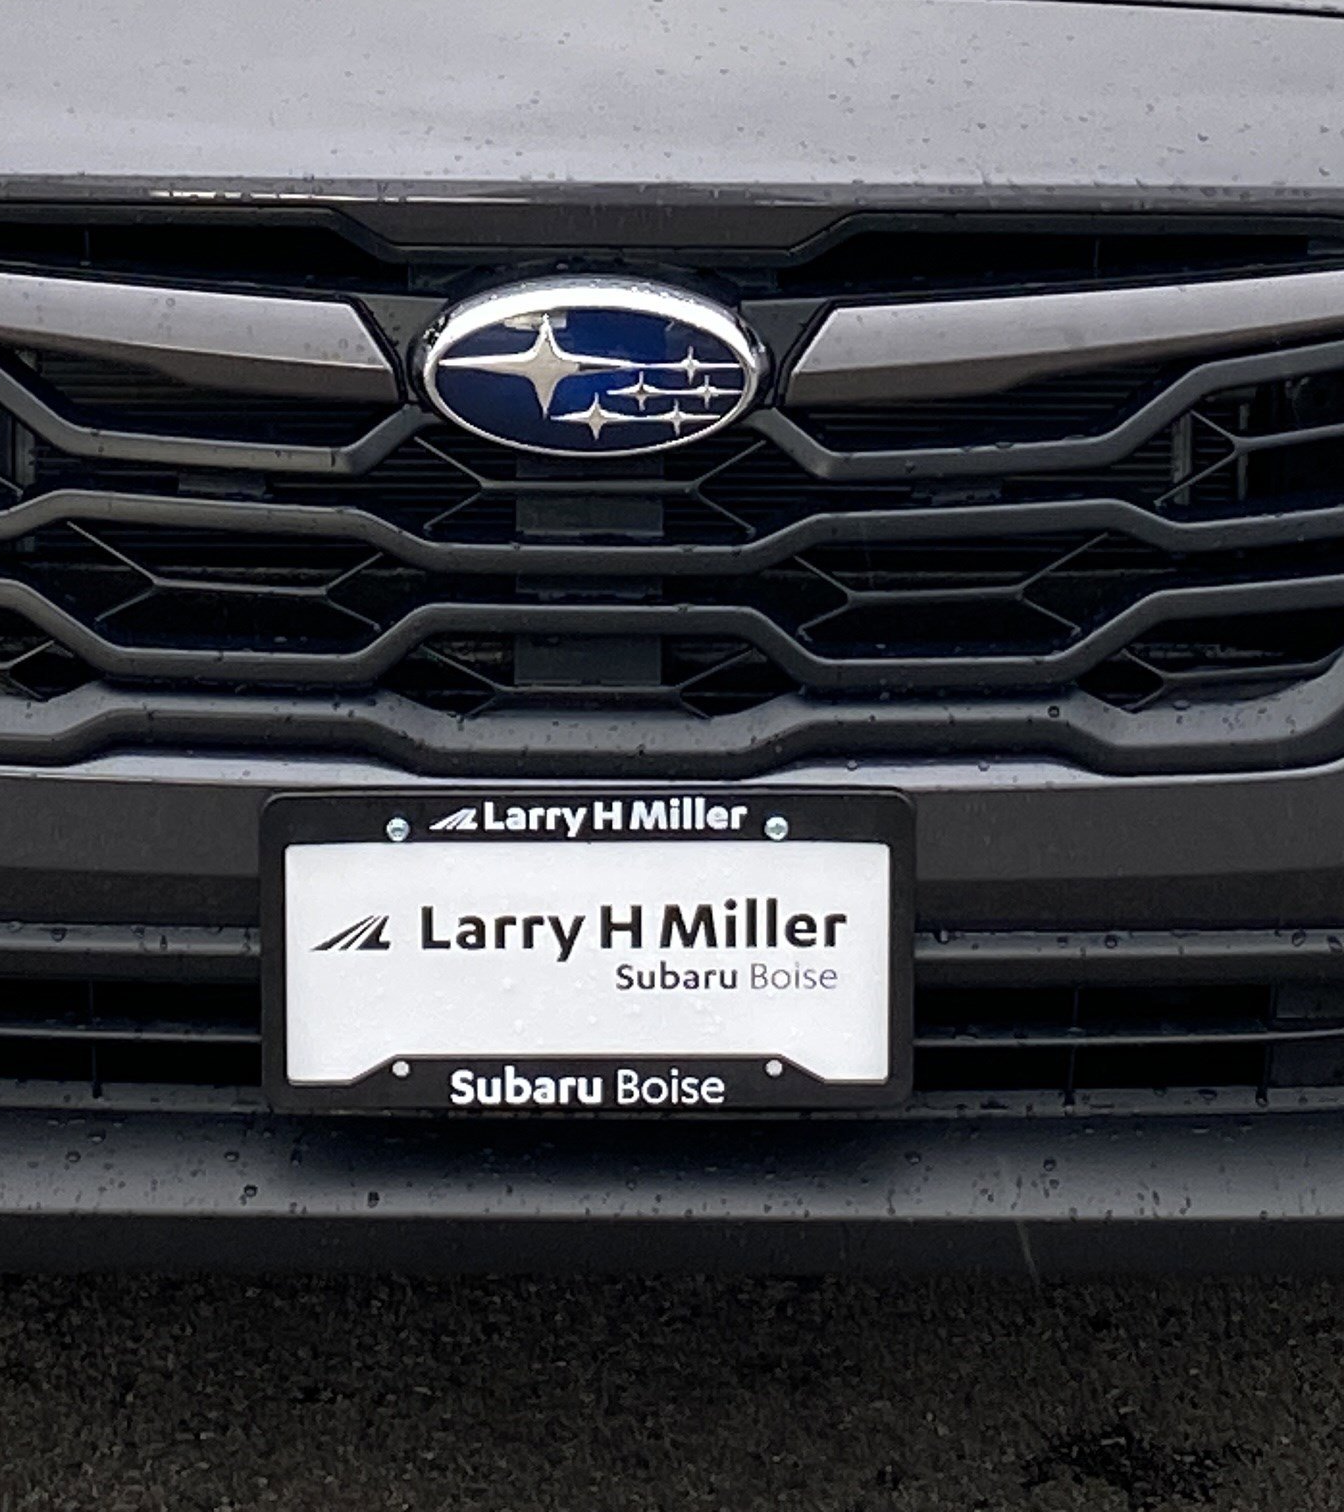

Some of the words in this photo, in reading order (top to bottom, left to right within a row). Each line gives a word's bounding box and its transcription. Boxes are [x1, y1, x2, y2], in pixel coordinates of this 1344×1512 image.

[484, 801, 588, 838] Larry
[593, 800, 623, 830] H
[629, 796, 749, 830] Miller
[421, 905, 586, 963] Larry
[600, 905, 643, 949] H
[659, 897, 848, 949] Miller
[615, 962, 738, 991] Subaru
[750, 962, 839, 990] Boise
[450, 1065, 603, 1105] Subaru
[617, 1067, 726, 1105] Boise
